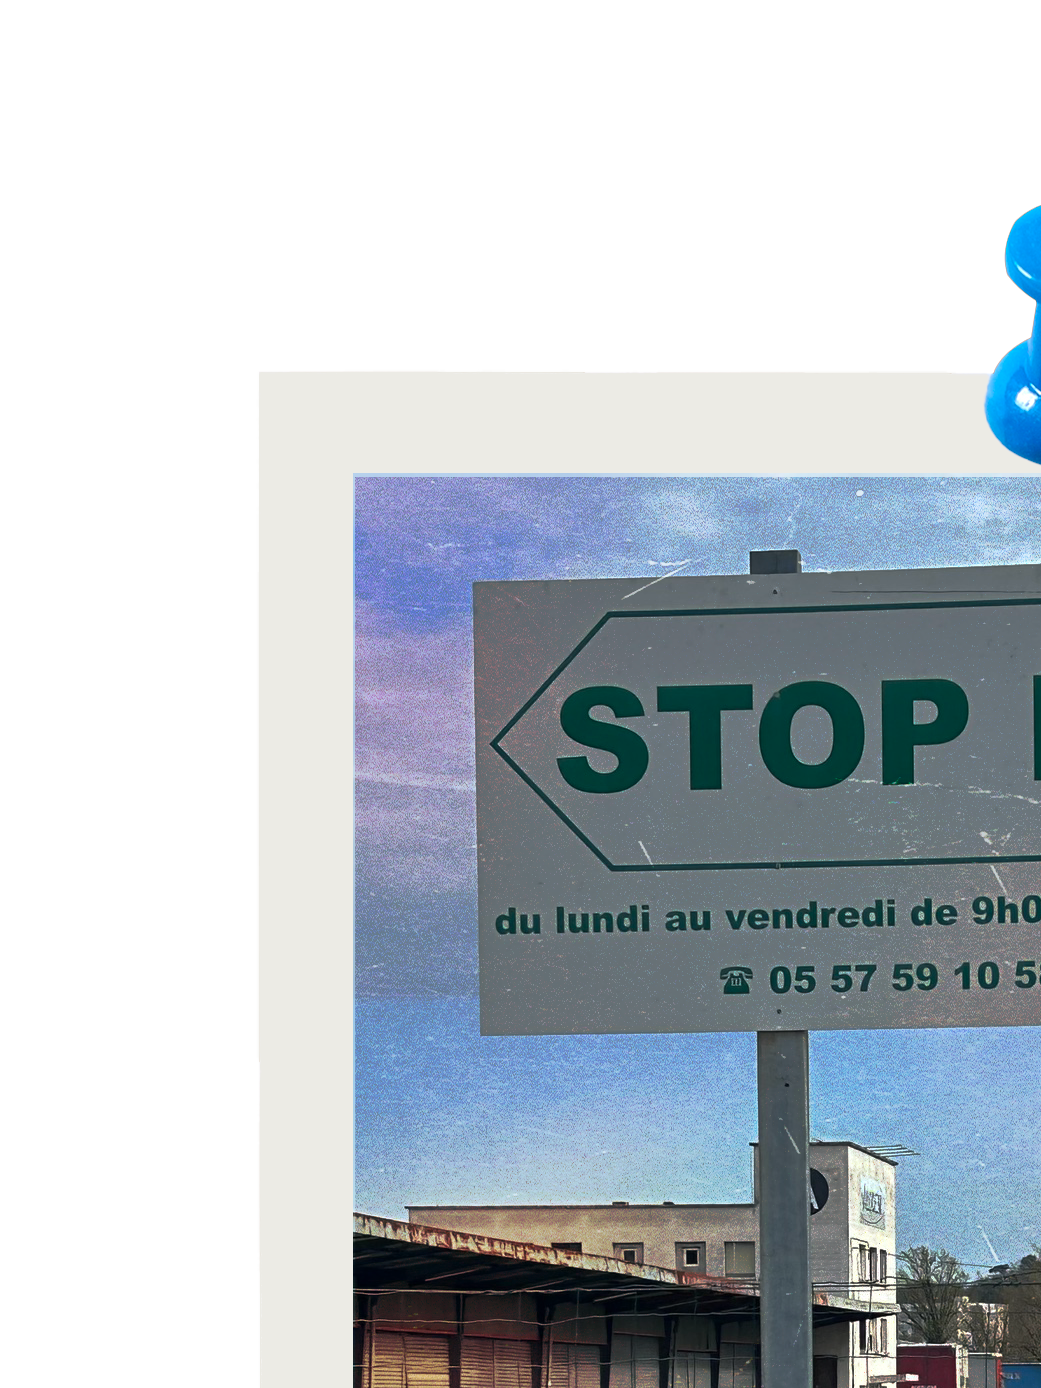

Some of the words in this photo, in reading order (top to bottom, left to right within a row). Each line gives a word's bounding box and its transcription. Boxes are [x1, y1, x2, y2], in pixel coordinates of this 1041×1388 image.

[556, 678, 970, 794] STOP
[495, 907, 541, 935] du
[556, 904, 650, 934] lundi
[665, 911, 711, 932] au
[725, 899, 896, 930] vendredi
[910, 898, 958, 927] de
[769, 965, 816, 994] 05
[831, 964, 877, 993] 57
[892, 962, 938, 992] 59
[953, 961, 1000, 990] 10
